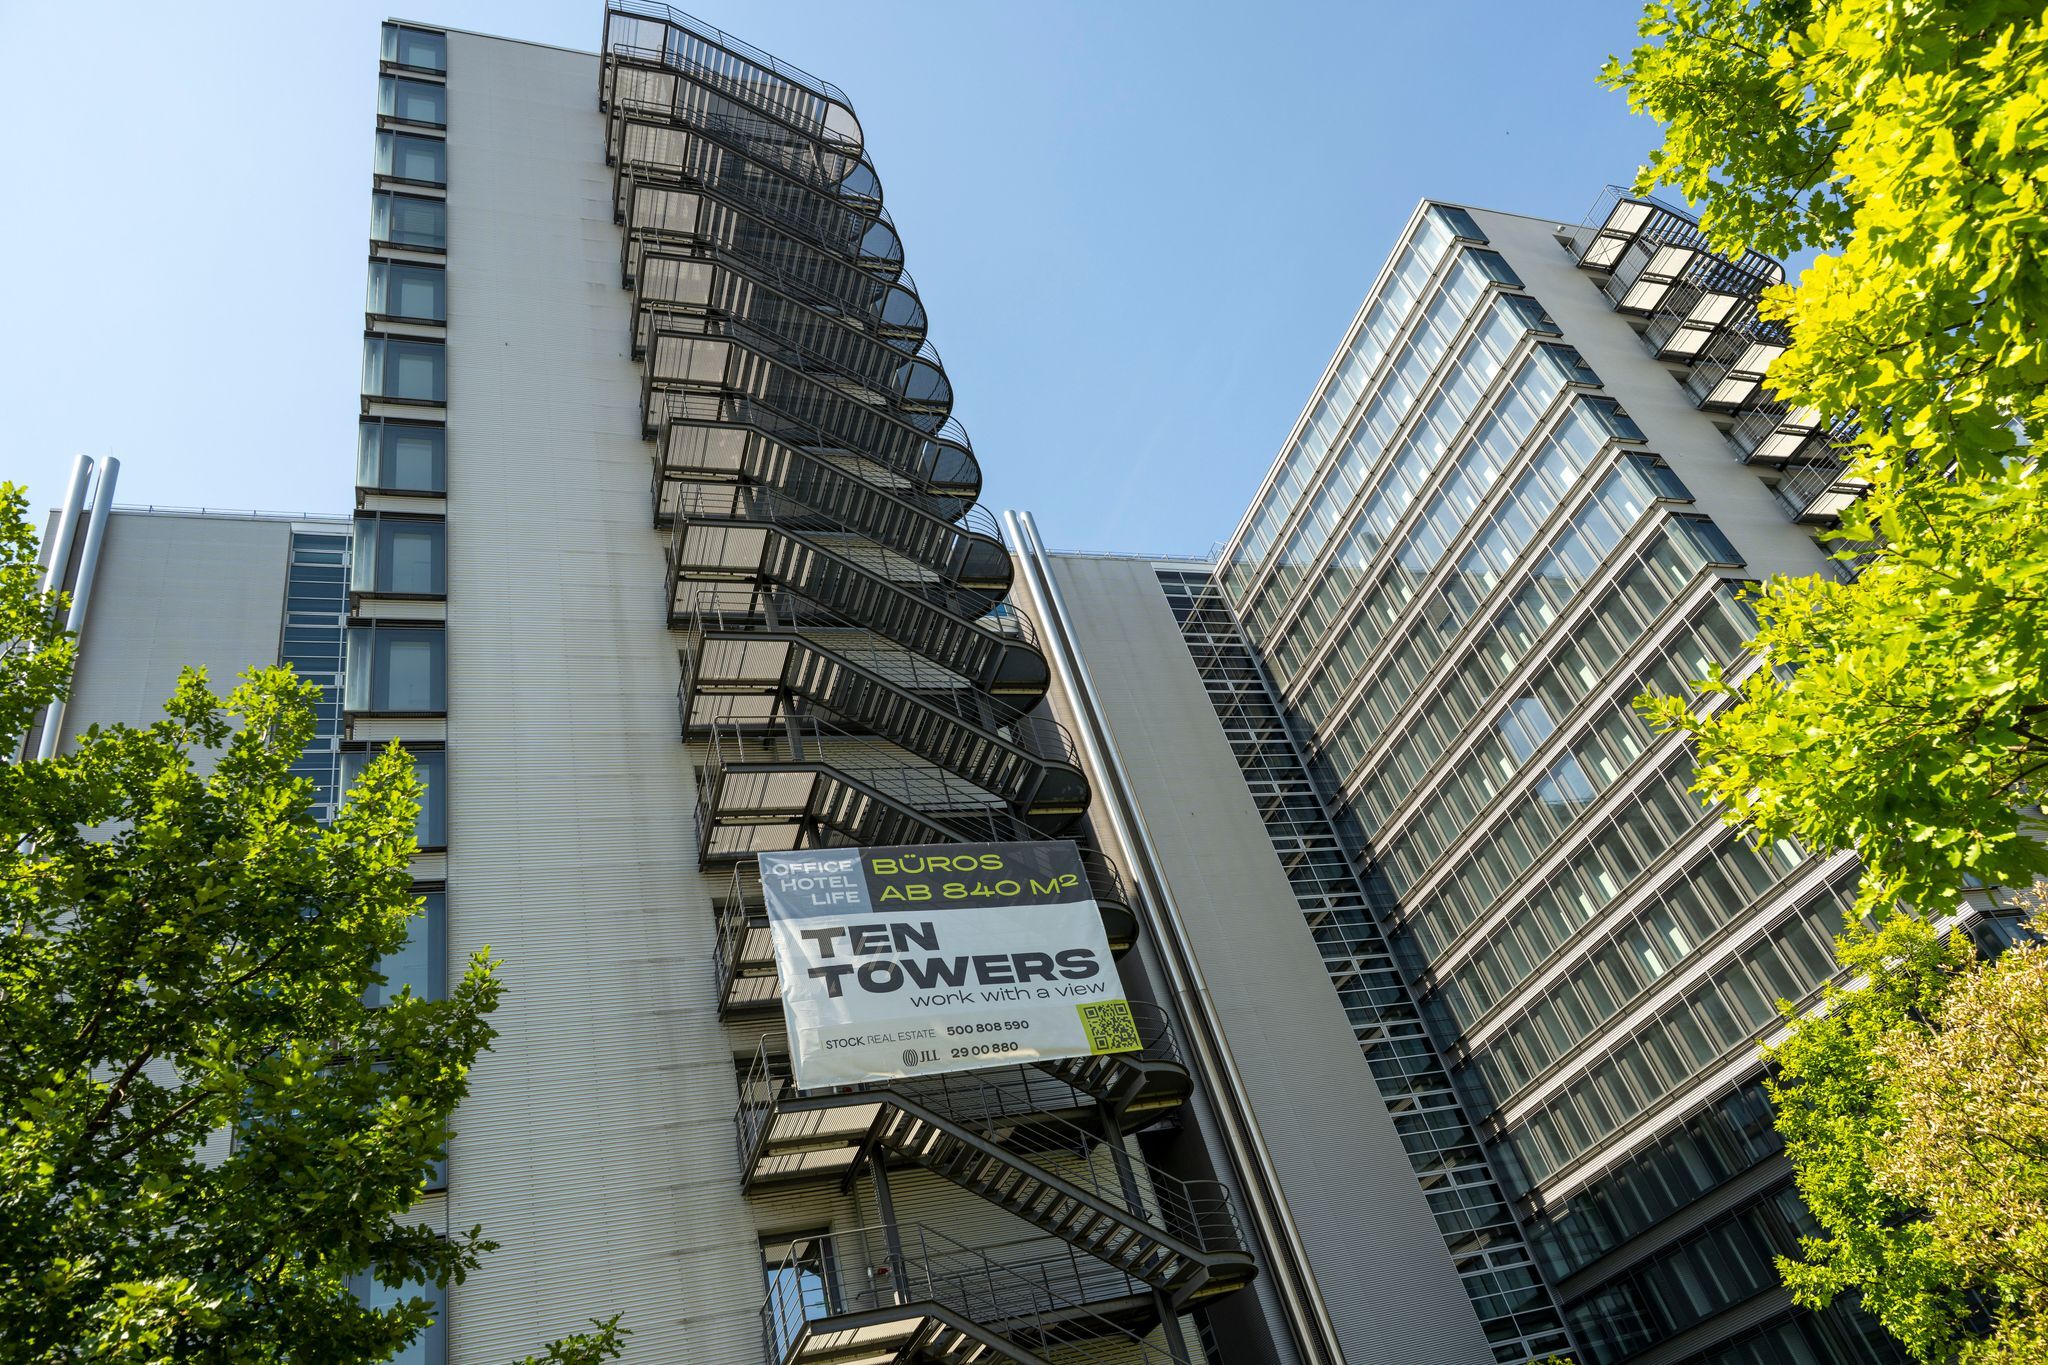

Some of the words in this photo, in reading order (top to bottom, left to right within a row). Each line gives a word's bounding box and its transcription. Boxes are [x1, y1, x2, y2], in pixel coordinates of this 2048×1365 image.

[772, 860, 853, 876] OFFICE
[871, 854, 1004, 875] BÜROS
[781, 875, 858, 892] HOTEL
[880, 884, 933, 902] AB
[942, 879, 1021, 899] 840
[812, 891, 861, 906] LIFE
[801, 922, 940, 959] TEN
[808, 948, 1100, 998] TOWERS
[910, 990, 976, 1008] work
[981, 986, 1031, 1002] with
[1036, 988, 1050, 999] a
[1055, 982, 1105, 997] view
[946, 1024, 974, 1036] 500
[976, 1022, 1002, 1033] 808
[1004, 1020, 1029, 1031] 590
[825, 1036, 866, 1050] STOCK
[867, 1034, 896, 1044] REAL
[897, 1028, 937, 1041] ESTATE
[992, 1041, 1019, 1053] 880
[919, 1049, 941, 1062] JLL
